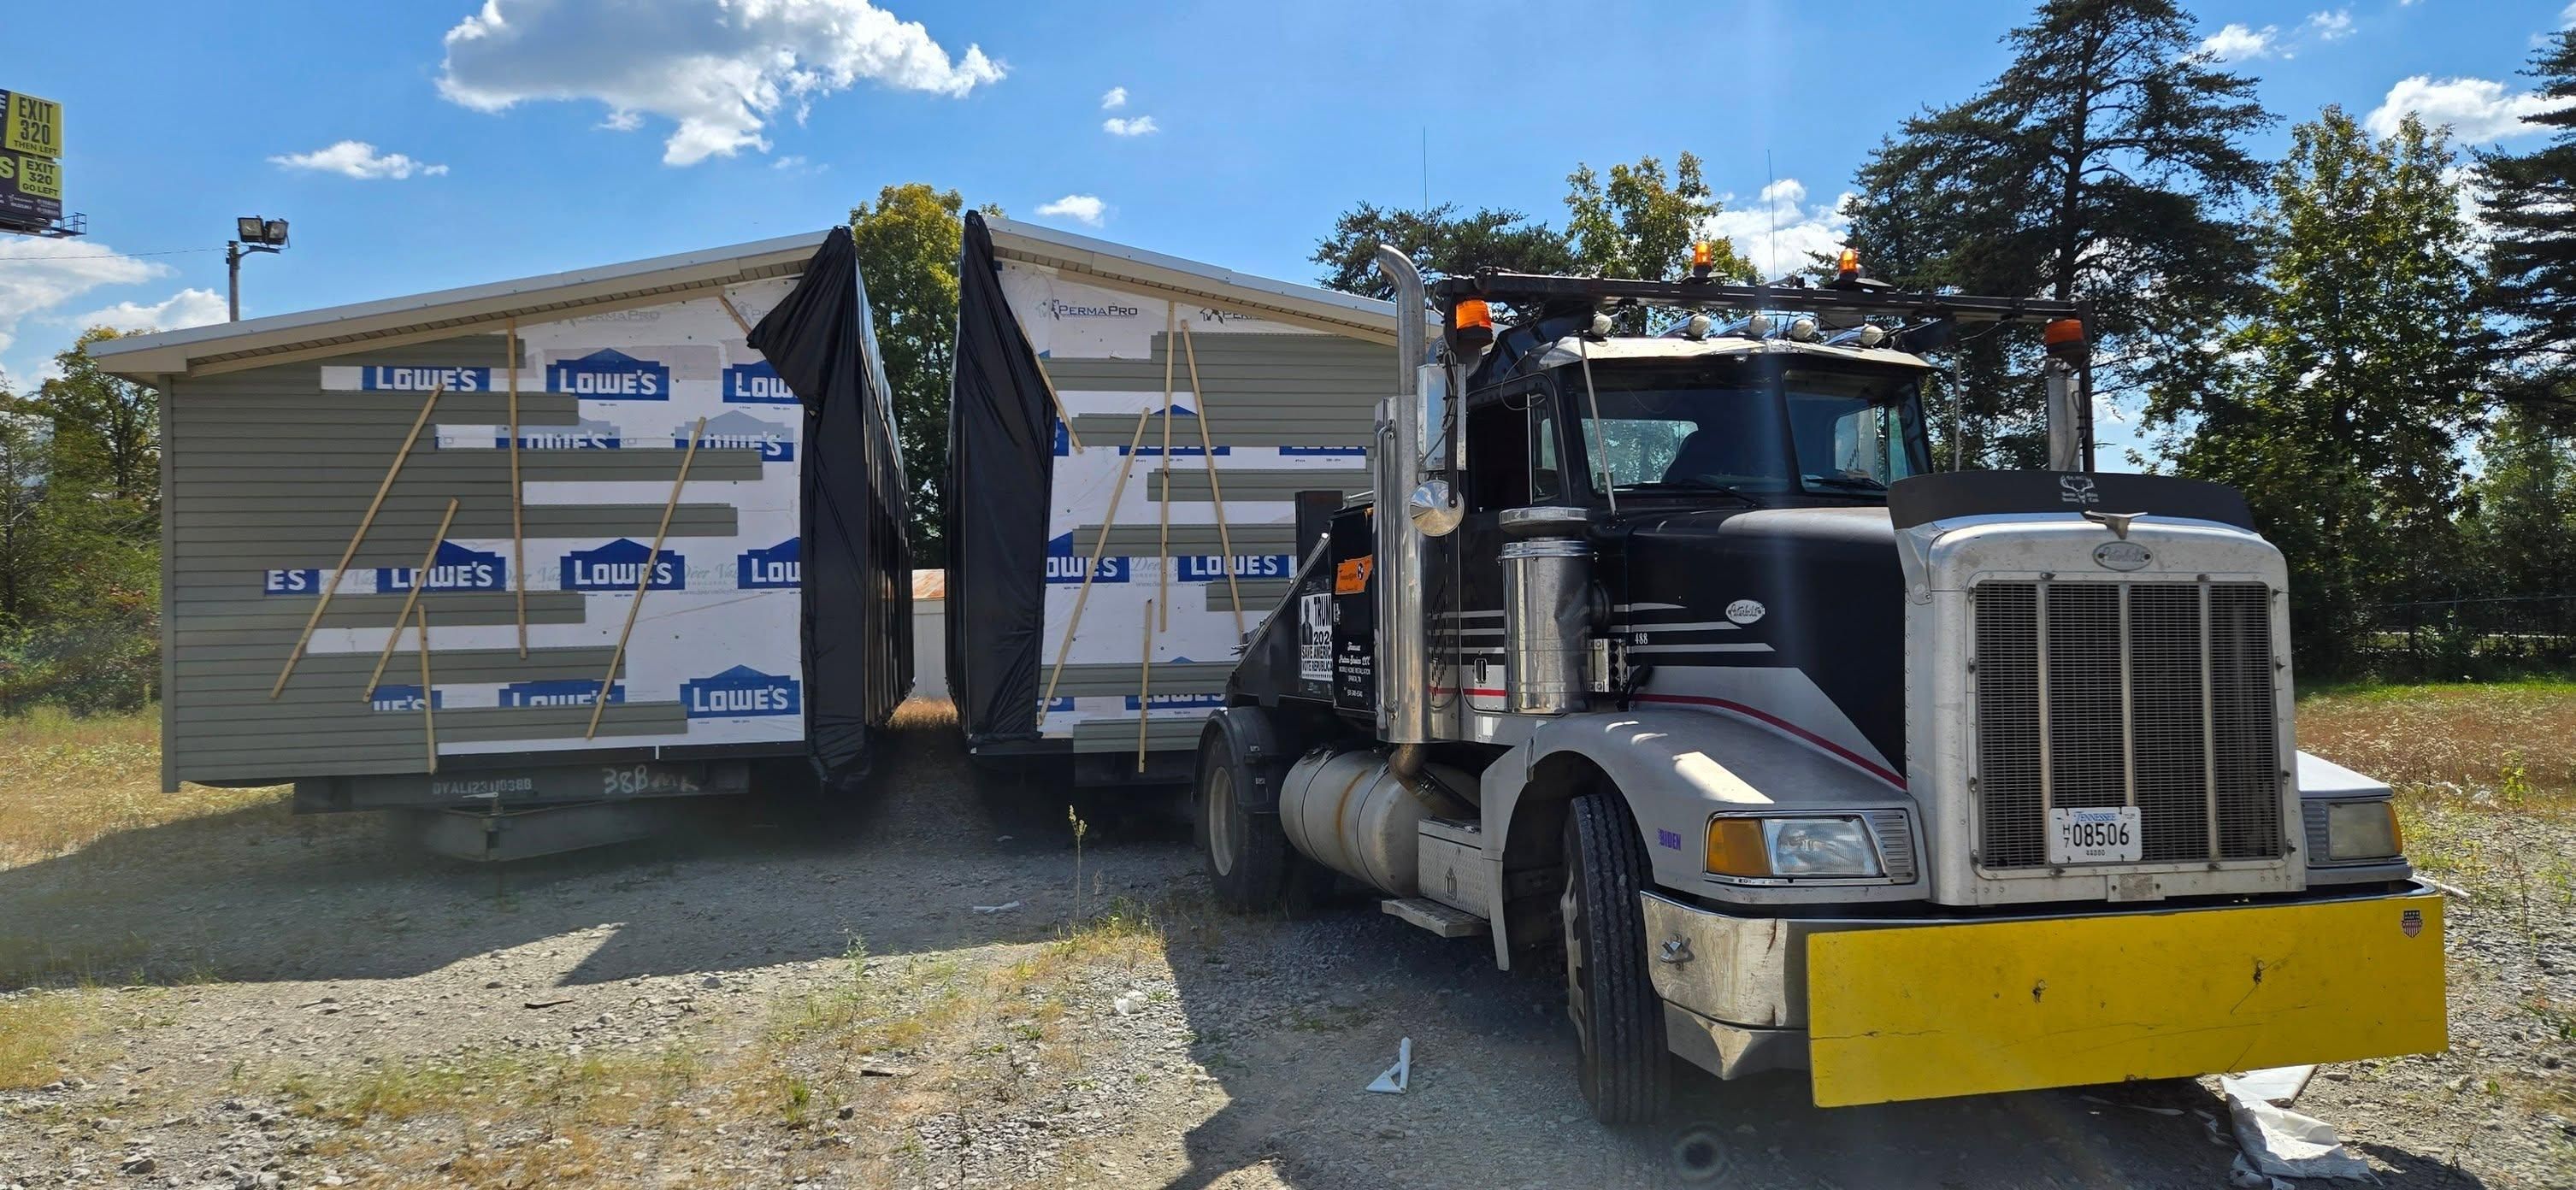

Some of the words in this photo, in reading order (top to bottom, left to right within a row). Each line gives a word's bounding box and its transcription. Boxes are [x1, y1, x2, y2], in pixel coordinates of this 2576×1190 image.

[19, 97, 54, 124] EXIT
[21, 120, 50, 145] 320
[14, 139, 37, 150] THEN
[39, 146, 57, 155] LEFT
[27, 160, 56, 174] EXIT
[22, 183, 36, 191] GO
[38, 186, 59, 196] LEFT
[29, 172, 52, 186] 320
[376, 367, 477, 392] LOWE'S
[557, 368, 657, 395] LOWE'S
[735, 372, 800, 398] LOW
[1635, 633, 1648, 645] 488
[693, 686, 788, 712] LOWE'S
[2073, 811, 2117, 824] TENNESSEE
[1659, 829, 1682, 851] BIDEN
[2073, 823, 2130, 847] 08506
